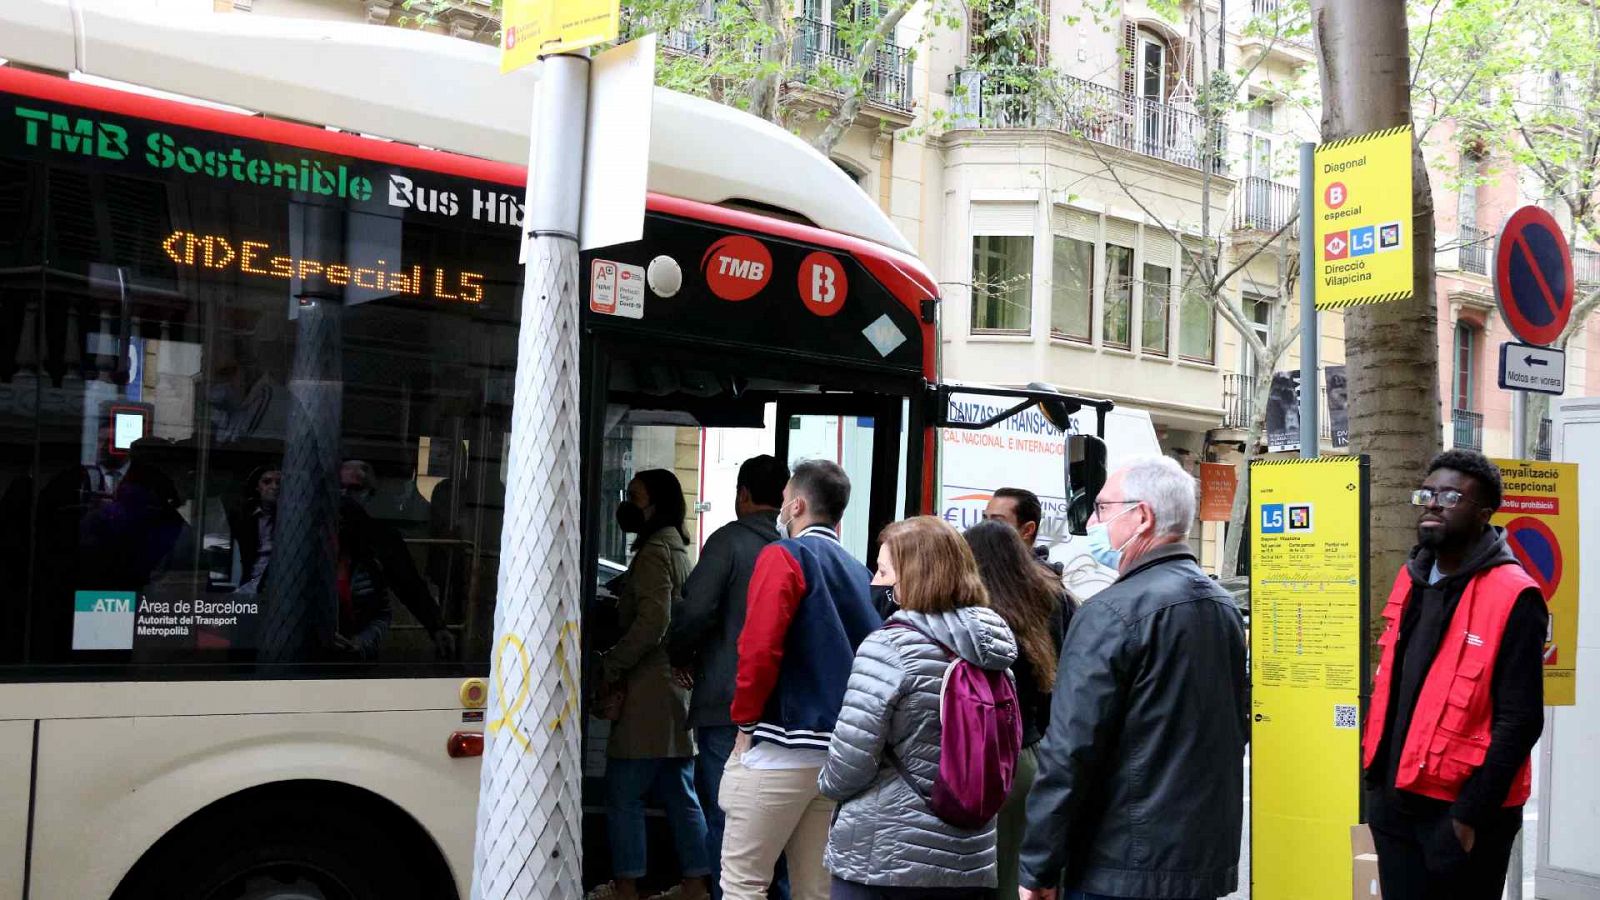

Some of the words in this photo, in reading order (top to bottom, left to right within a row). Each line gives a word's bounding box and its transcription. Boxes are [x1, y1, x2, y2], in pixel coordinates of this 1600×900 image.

[15, 106, 129, 160] TMB
[145, 132, 373, 201] Sostenible
[388, 174, 459, 217] Bus
[472, 189, 526, 228] Híb
[1324, 156, 1367, 174] Diagonal
[1329, 186, 1343, 205] B
[1324, 205, 1362, 221] especial
[1352, 232, 1374, 251] L5
[718, 255, 765, 282] TMB
[1325, 260, 1366, 275] Direcció
[435, 268, 484, 302] L5
[811, 263, 836, 304] B
[1325, 272, 1372, 287] Vilapicina
[949, 400, 995, 423] DANZAS
[943, 428, 960, 443] CAL
[962, 431, 1005, 449] NACIONAL
[1008, 436, 1015, 450] E
[1016, 437, 1065, 456] INTERNACIO
[1500, 467, 1559, 479] enyalització
[1503, 481, 1557, 493] xcepcional
[1503, 500, 1519, 508] otiu
[1262, 510, 1282, 528] L5
[93, 599, 130, 613] ATM
[139, 595, 169, 614] Àrea
[174, 600, 191, 614] de
[194, 600, 258, 614] Barcelona
[138, 615, 178, 626] Autoritat
[180, 615, 194, 626] del
[196, 616, 237, 627] Transport
[137, 627, 189, 637] Metropolità
